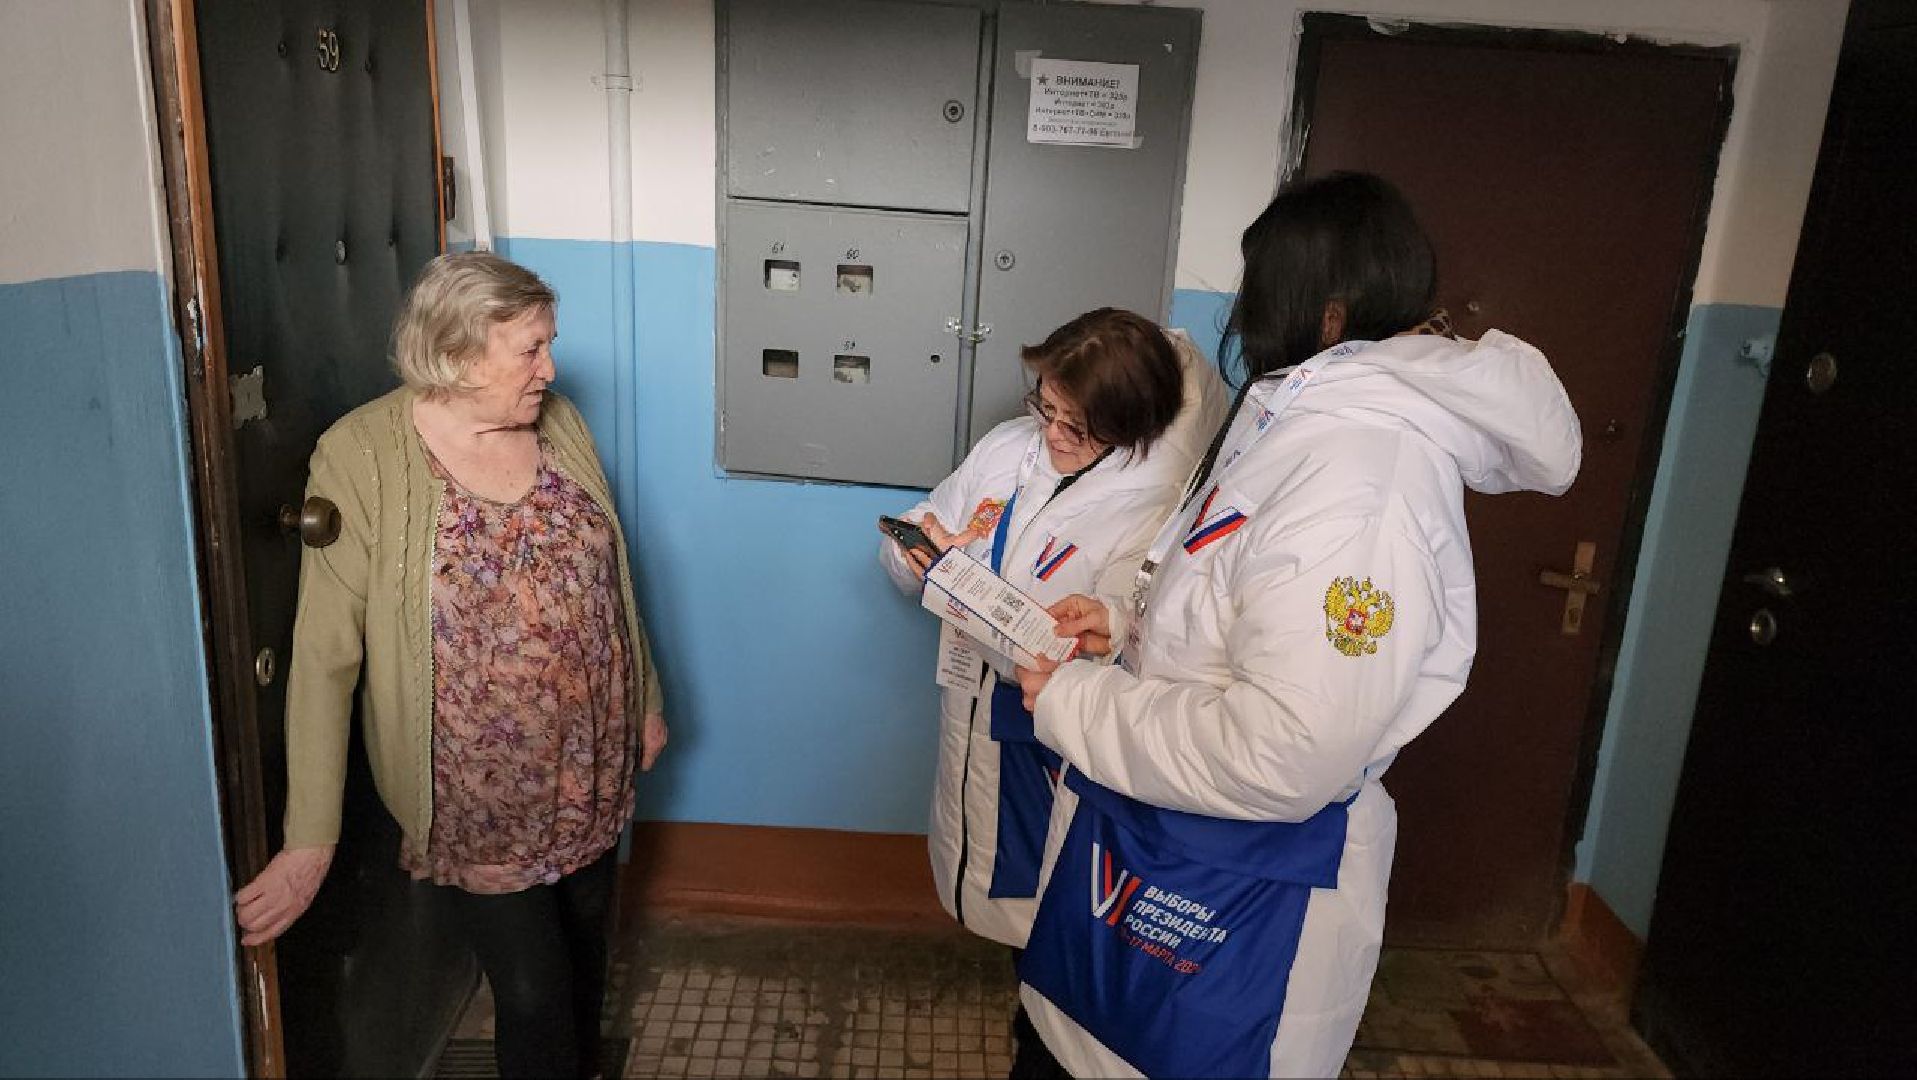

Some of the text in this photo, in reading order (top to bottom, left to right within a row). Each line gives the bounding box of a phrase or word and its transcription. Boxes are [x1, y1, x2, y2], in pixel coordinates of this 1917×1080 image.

[319, 29, 339, 71] 59
[1056, 75, 1120, 89] ВНИМАНИЕ!
[847, 248, 860, 260] 60
[1132, 900, 1228, 944] ПРЕЗИДЕНТА
[1144, 885, 1217, 923] ВЫБОРЫ
[1126, 914, 1182, 949] РОССИИ
